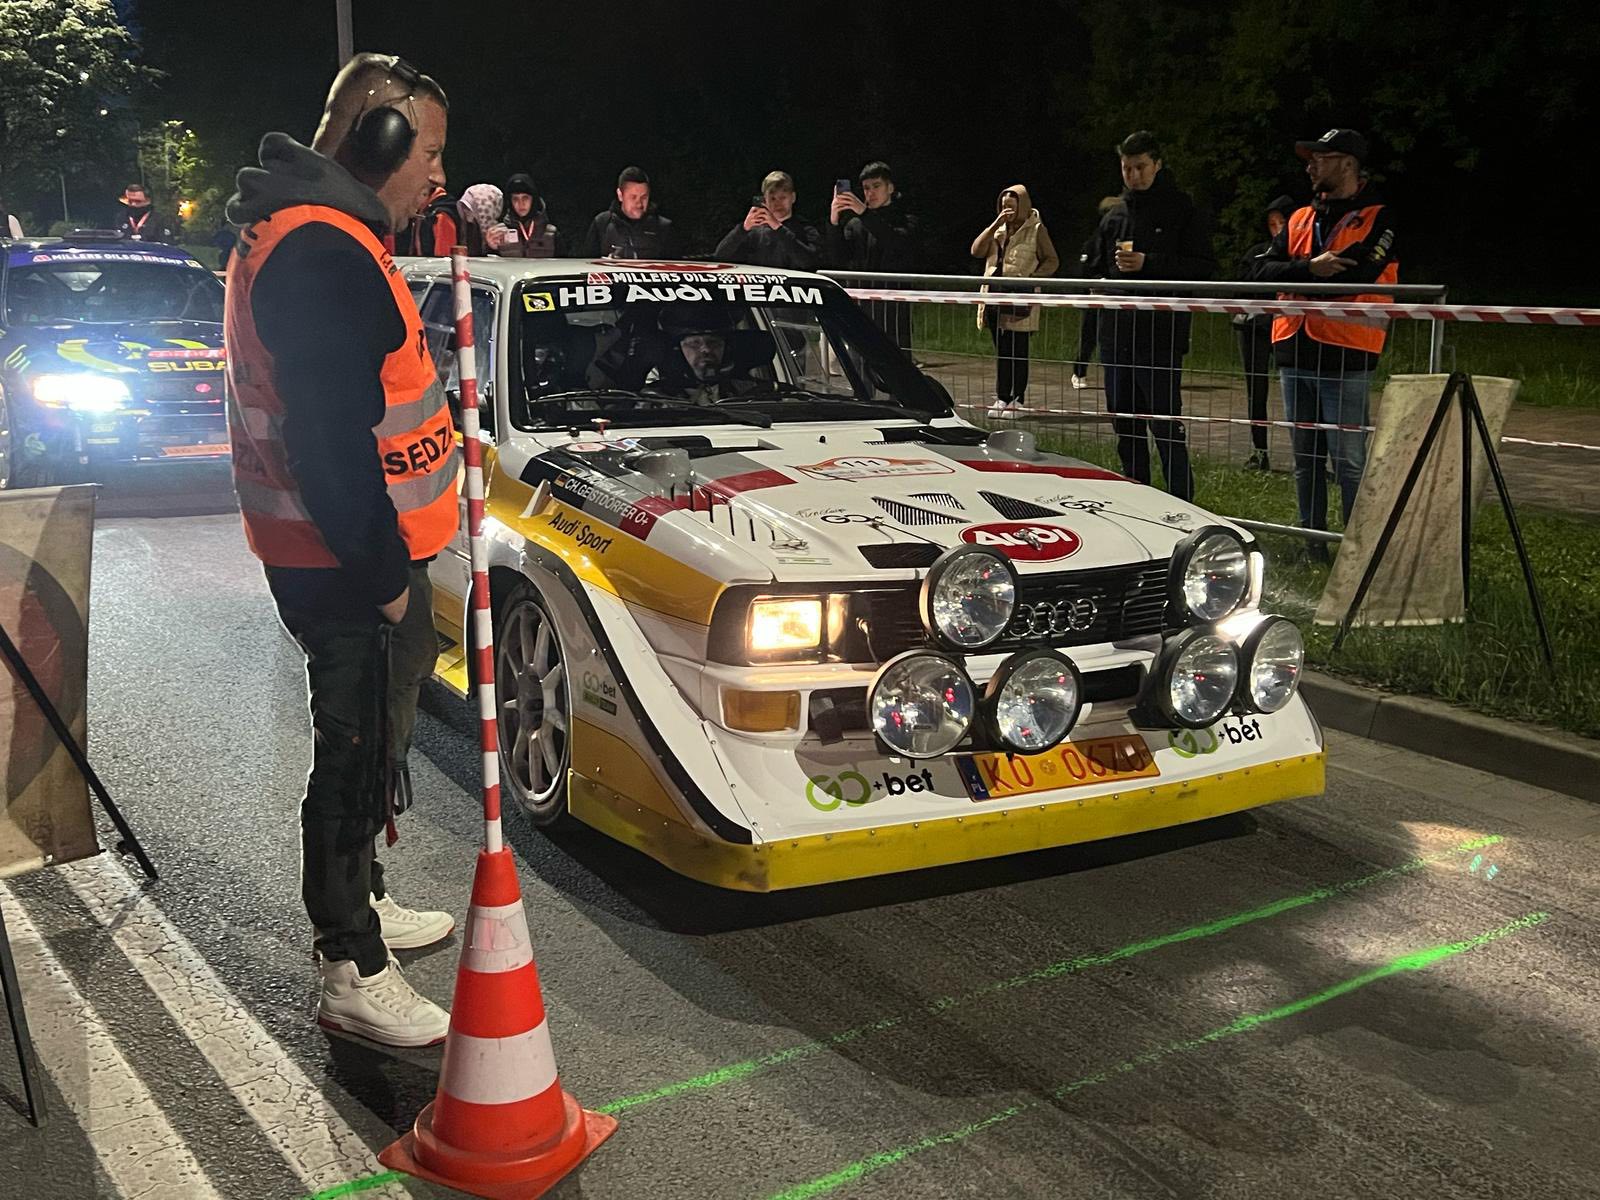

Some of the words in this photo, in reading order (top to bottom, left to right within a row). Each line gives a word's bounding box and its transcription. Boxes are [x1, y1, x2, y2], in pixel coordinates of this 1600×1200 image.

[612, 272, 681, 283] MILLERS
[683, 273, 718, 283] OILS
[559, 285, 613, 306] HB
[718, 284, 823, 305] TEAM
[548, 511, 582, 536] Audi
[576, 524, 614, 554] Sport
